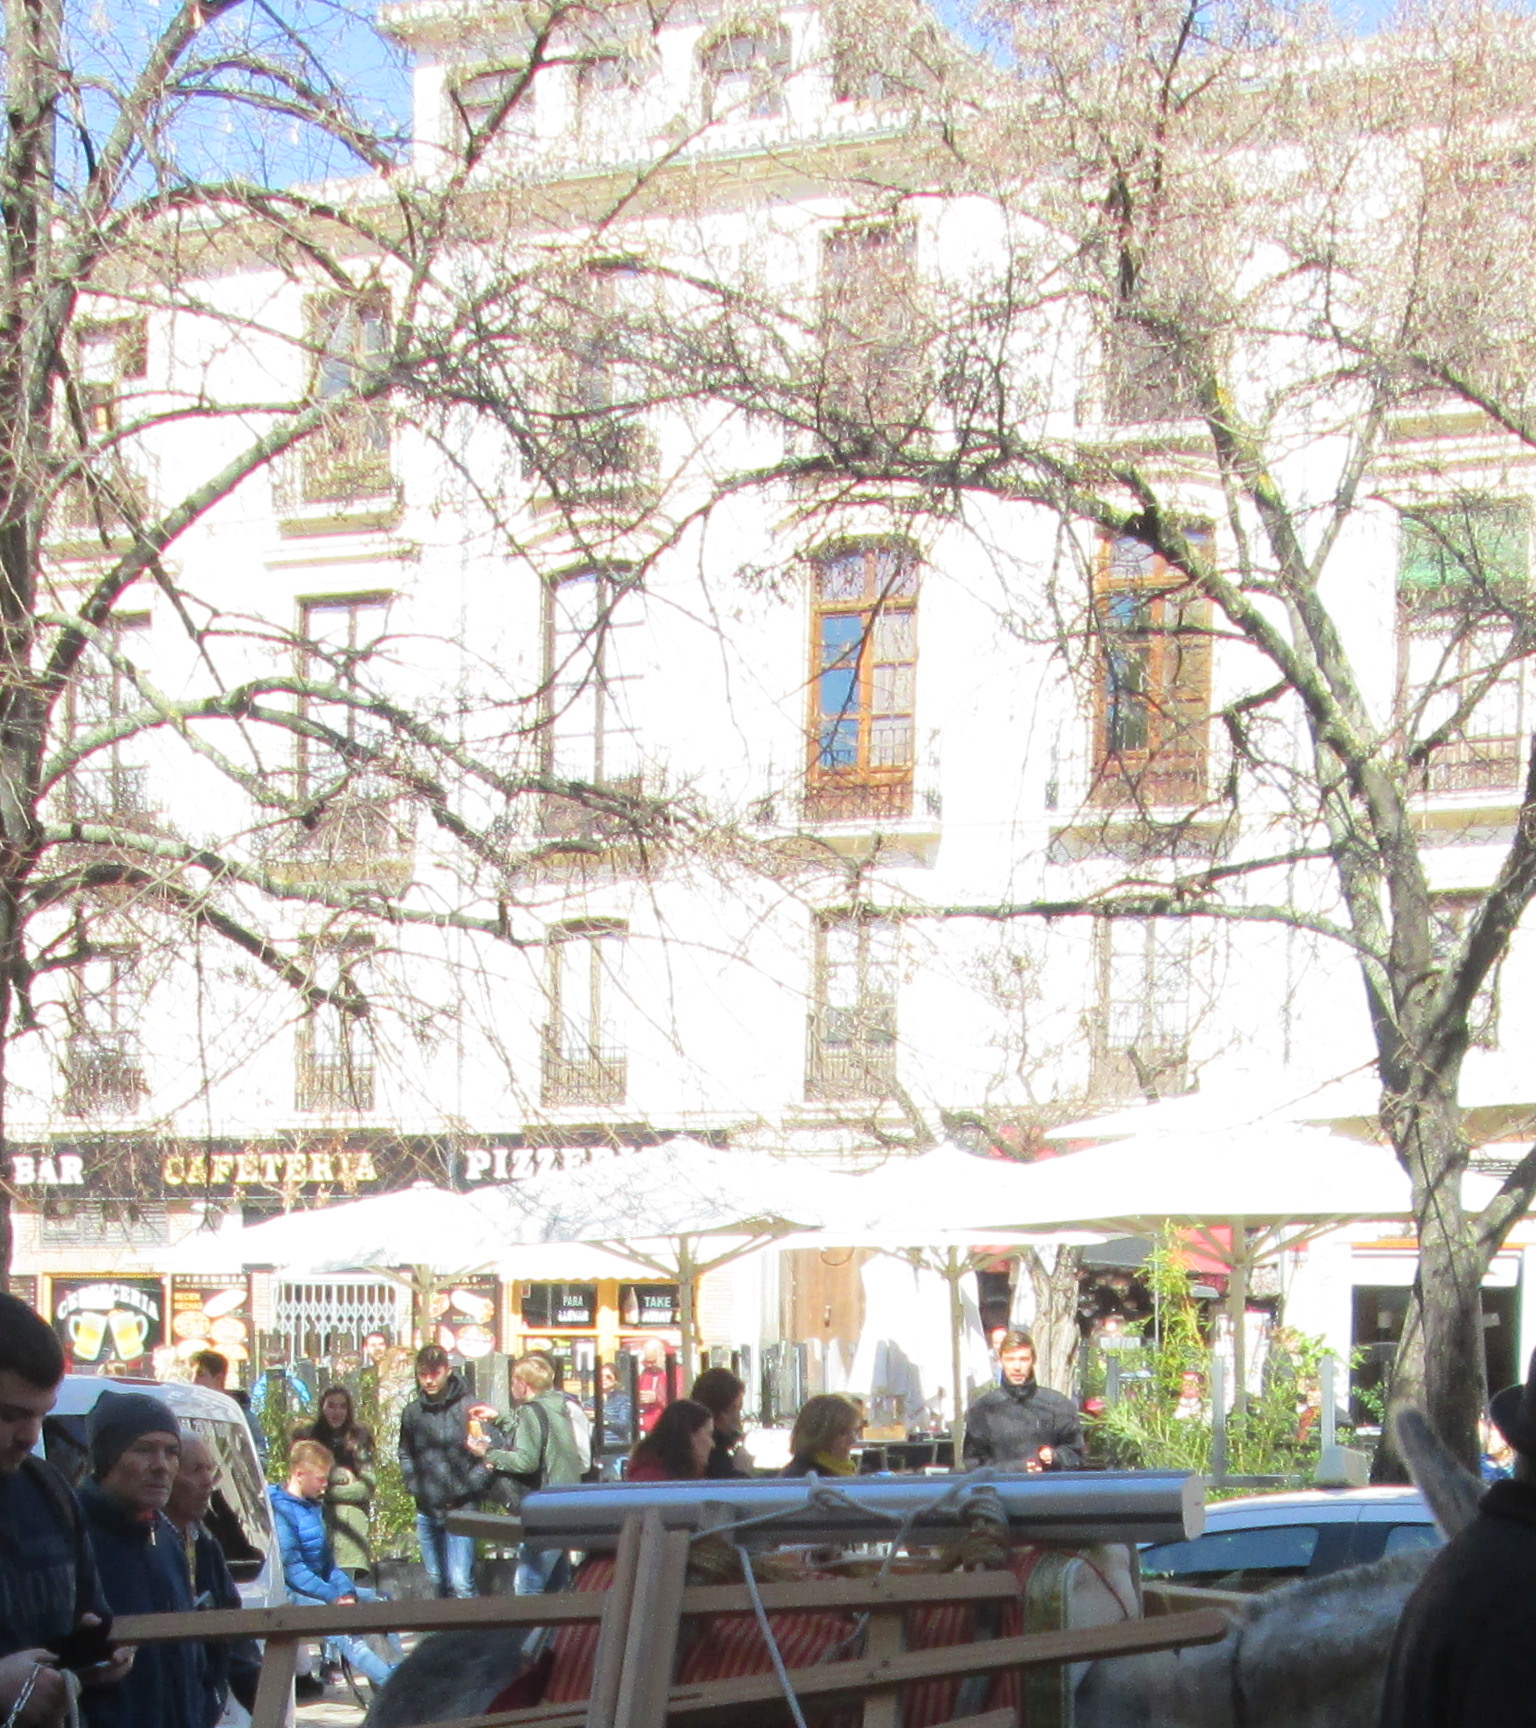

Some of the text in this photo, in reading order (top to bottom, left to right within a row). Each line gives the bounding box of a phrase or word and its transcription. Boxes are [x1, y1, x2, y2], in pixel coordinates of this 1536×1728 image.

[12, 1154, 85, 1185] BAR
[164, 1153, 379, 1185] CAFETERIA
[464, 1146, 650, 1181] PIZZE
[643, 1296, 672, 1308] TAKE
